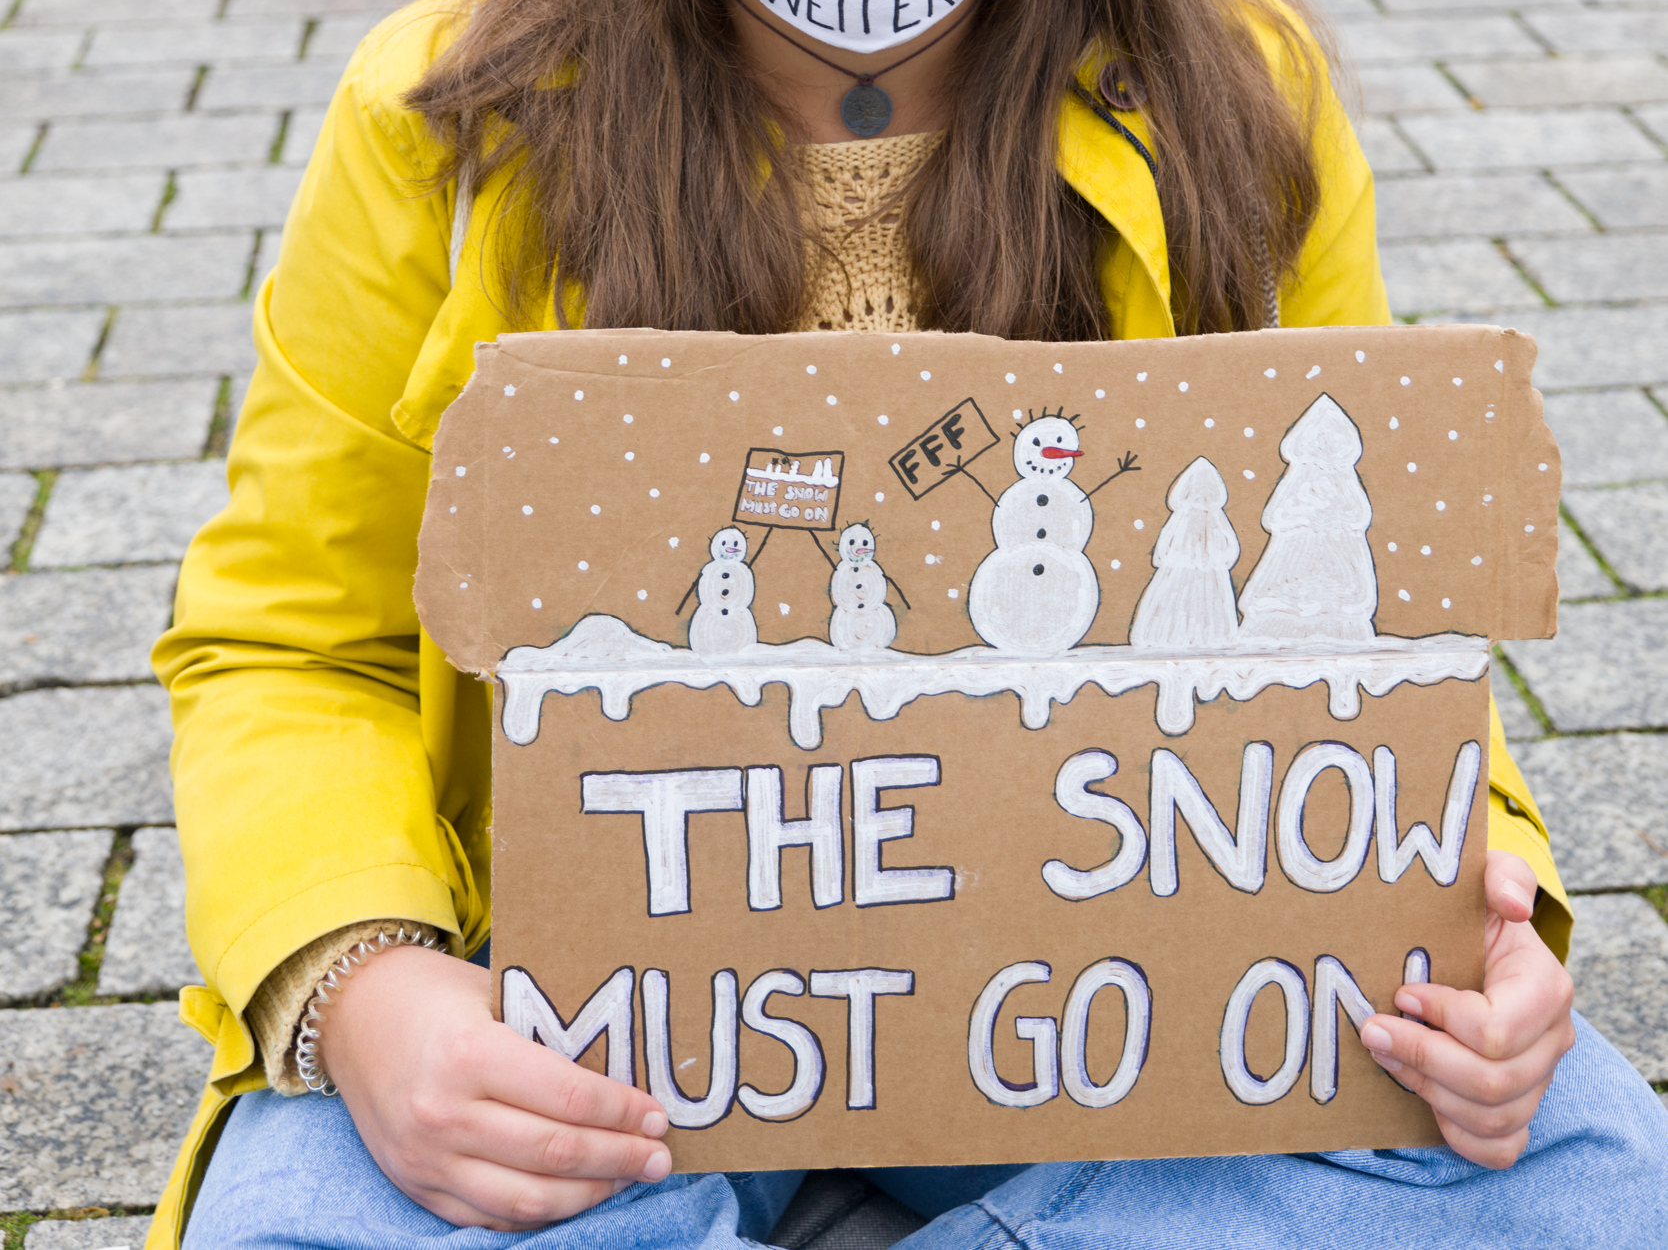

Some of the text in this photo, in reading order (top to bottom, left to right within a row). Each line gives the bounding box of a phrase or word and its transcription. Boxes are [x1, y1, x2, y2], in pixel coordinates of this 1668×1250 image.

[897, 413, 965, 485] FFF
[740, 498, 829, 522] MUST GO ON
[745, 479, 828, 502] THE SNOW
[580, 739, 1481, 918] THE SNOW
[501, 965, 916, 1131] MUST
[967, 956, 1153, 1109] GO
